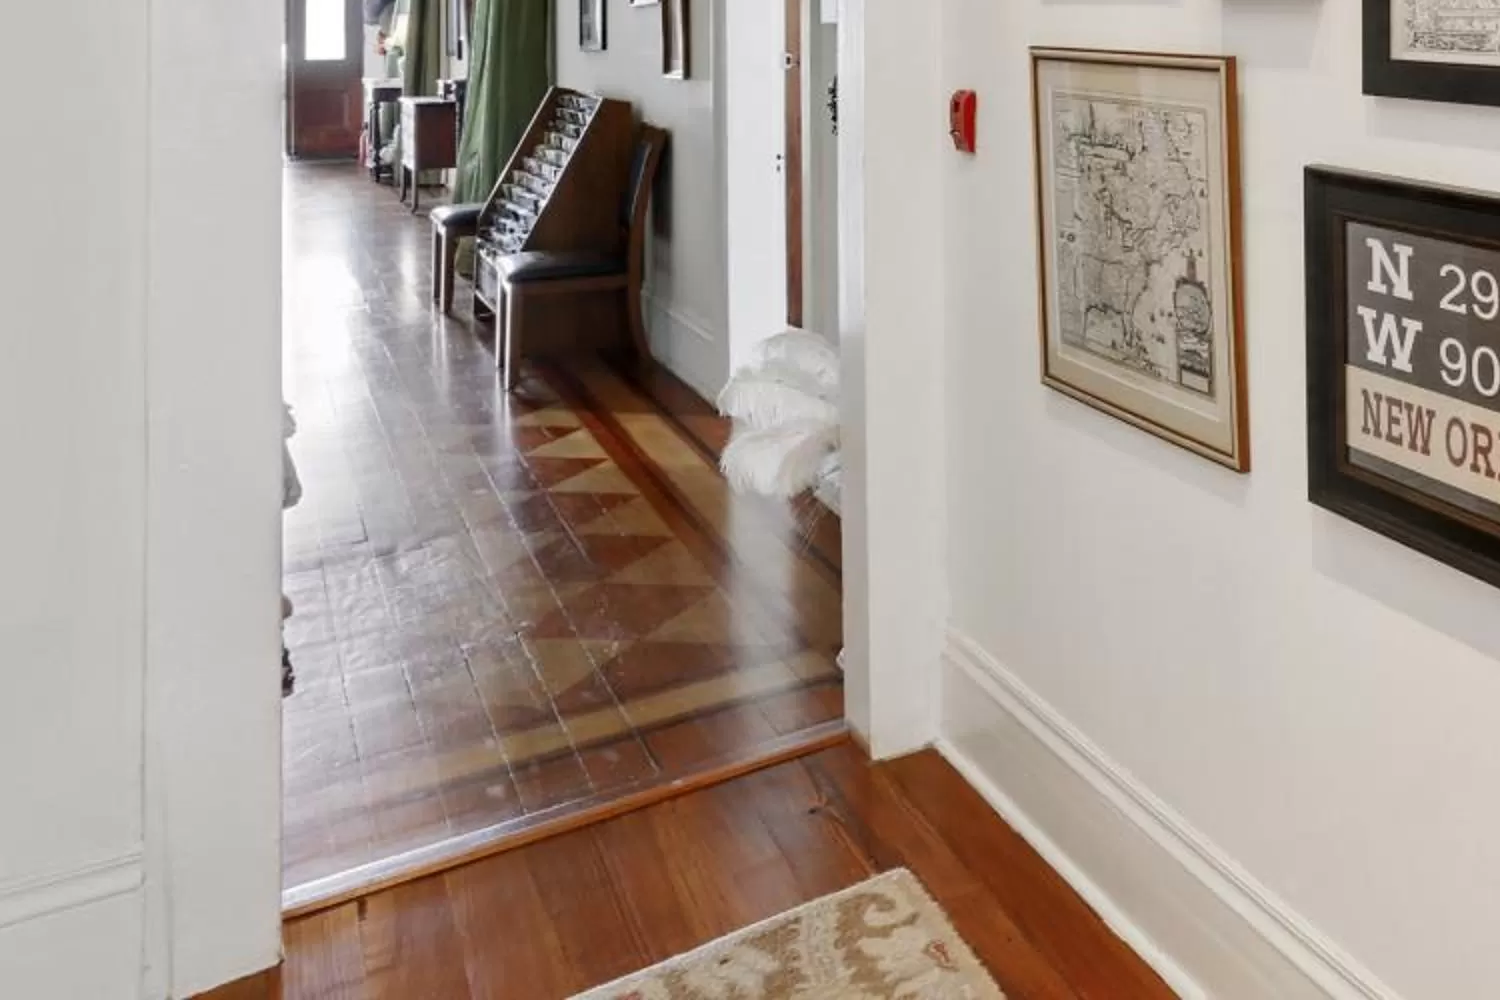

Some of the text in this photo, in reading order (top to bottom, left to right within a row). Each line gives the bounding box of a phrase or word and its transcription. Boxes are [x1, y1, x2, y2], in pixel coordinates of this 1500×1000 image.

[1366, 238, 1414, 299] N
[1358, 306, 1422, 373] W
[1361, 388, 1435, 456] NEW
